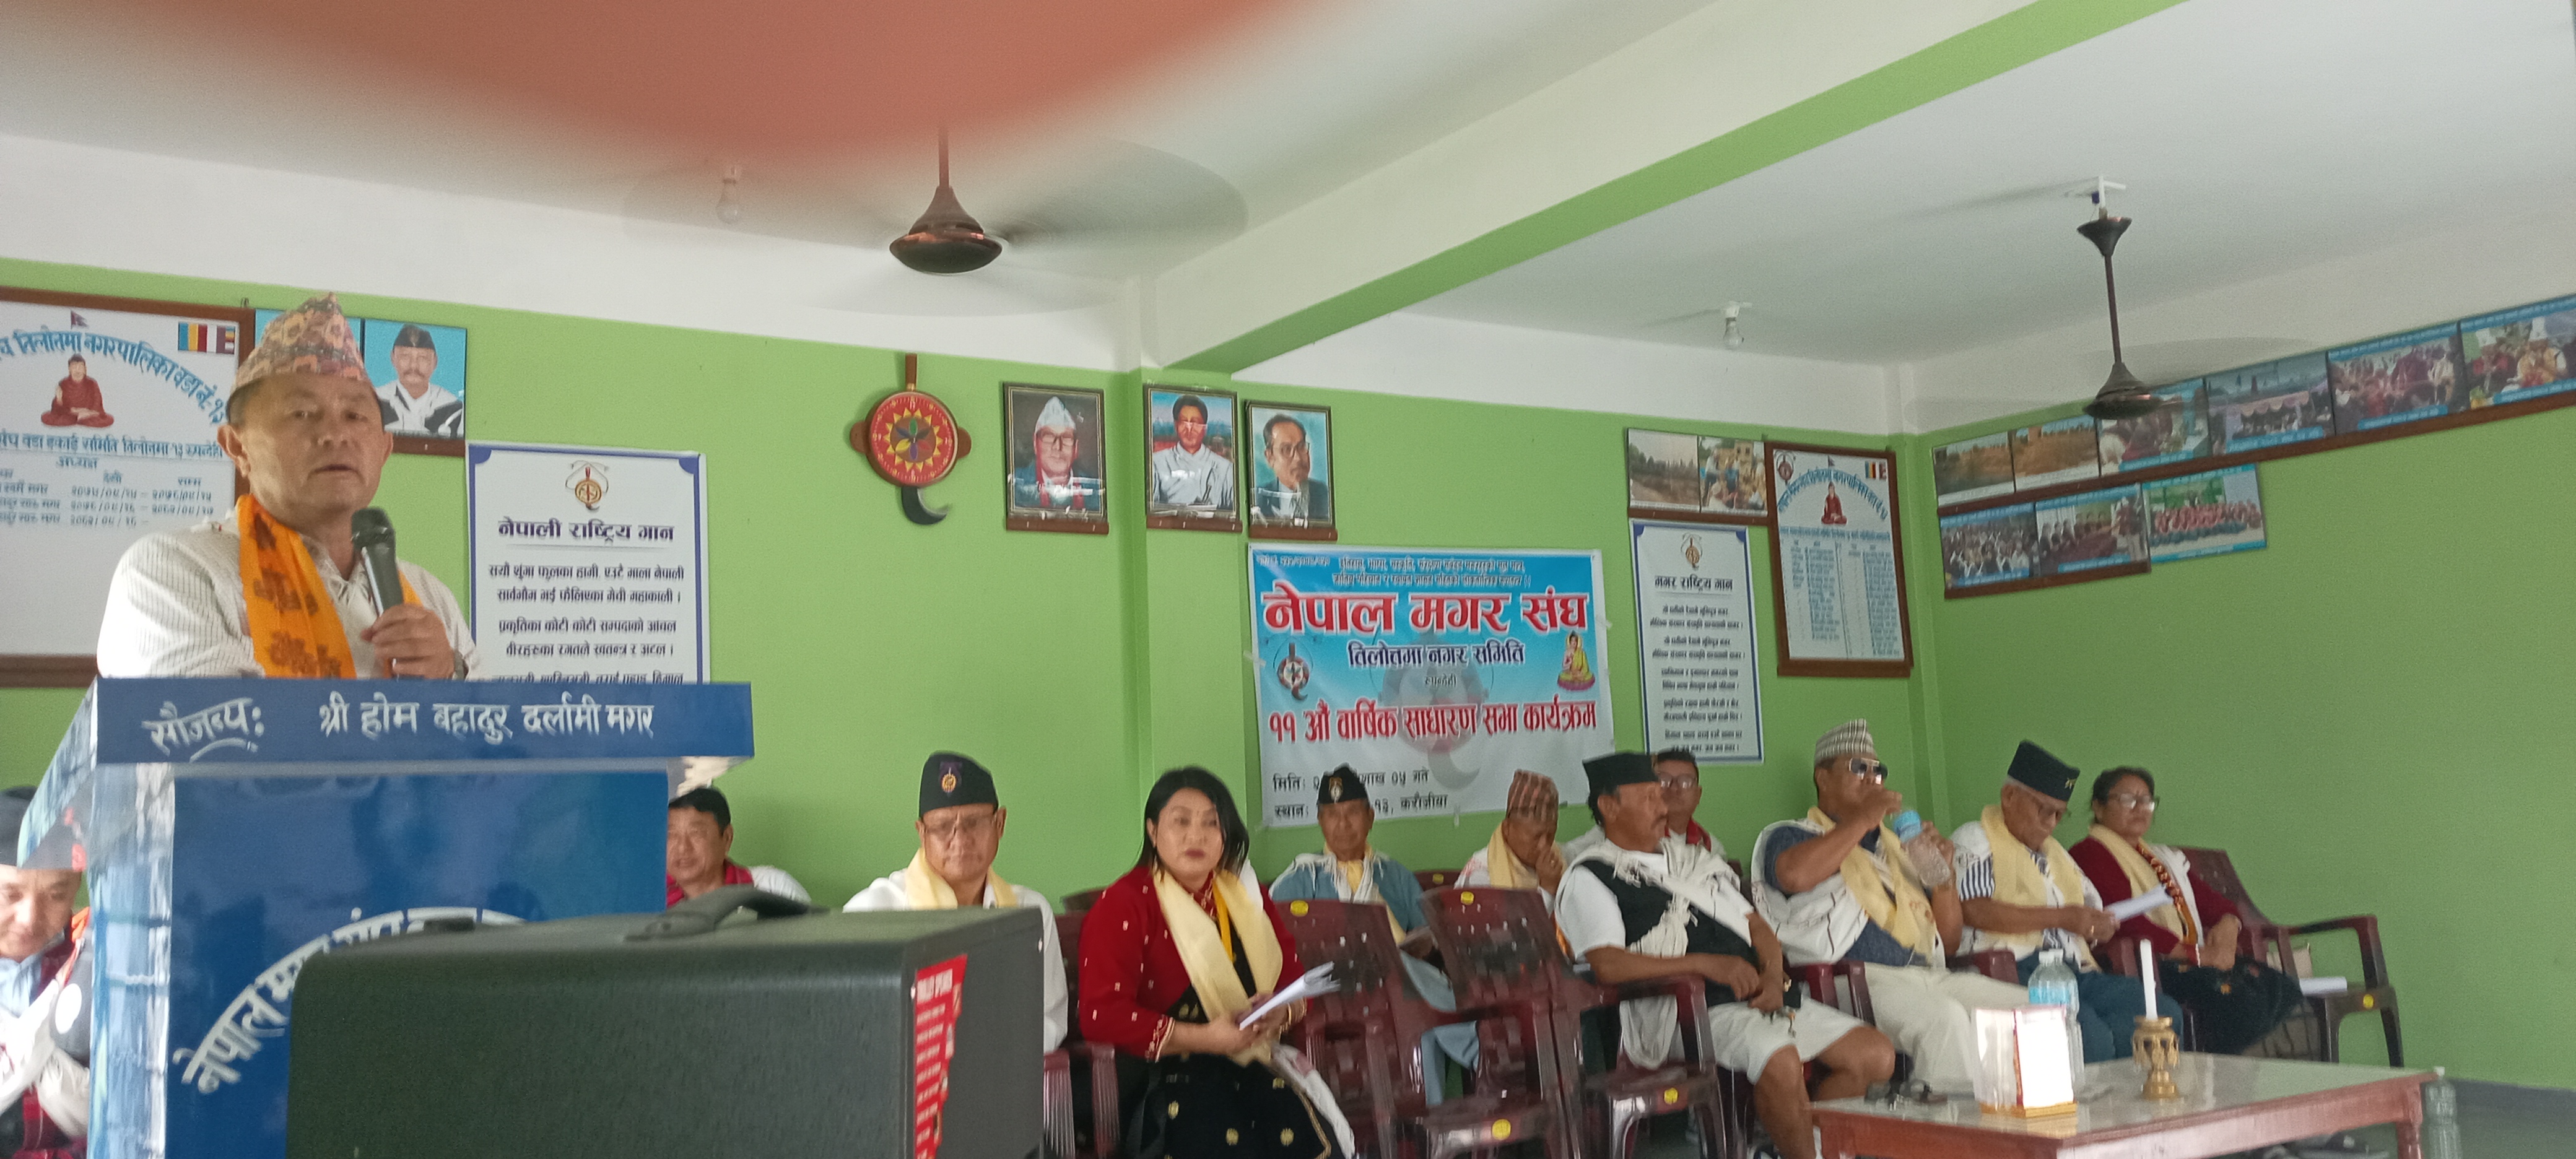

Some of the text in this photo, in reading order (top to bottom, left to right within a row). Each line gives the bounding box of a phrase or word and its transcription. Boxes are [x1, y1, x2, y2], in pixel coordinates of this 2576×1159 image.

[497, 516, 674, 545] नेपाली राष्ट्रिय गान
[627, 566, 651, 581] माला
[655, 564, 684, 581] नेपाली
[1262, 581, 1588, 634] नेपाल मगर संघ
[1426, 645, 1469, 665] नगर
[1471, 638, 1525, 665] समिति
[319, 690, 350, 737] श्री
[360, 692, 420, 739] होम
[432, 703, 513, 745] बहादुर
[604, 704, 655, 739] मगर
[1269, 711, 1297, 743] ११
[1336, 697, 1398, 741] वार्षिक
[1402, 704, 1477, 740] साधारण
[1482, 703, 1518, 737] सभा
[1523, 693, 1597, 732] कार्यक्रम
[172, 983, 289, 1094] नेपाल
